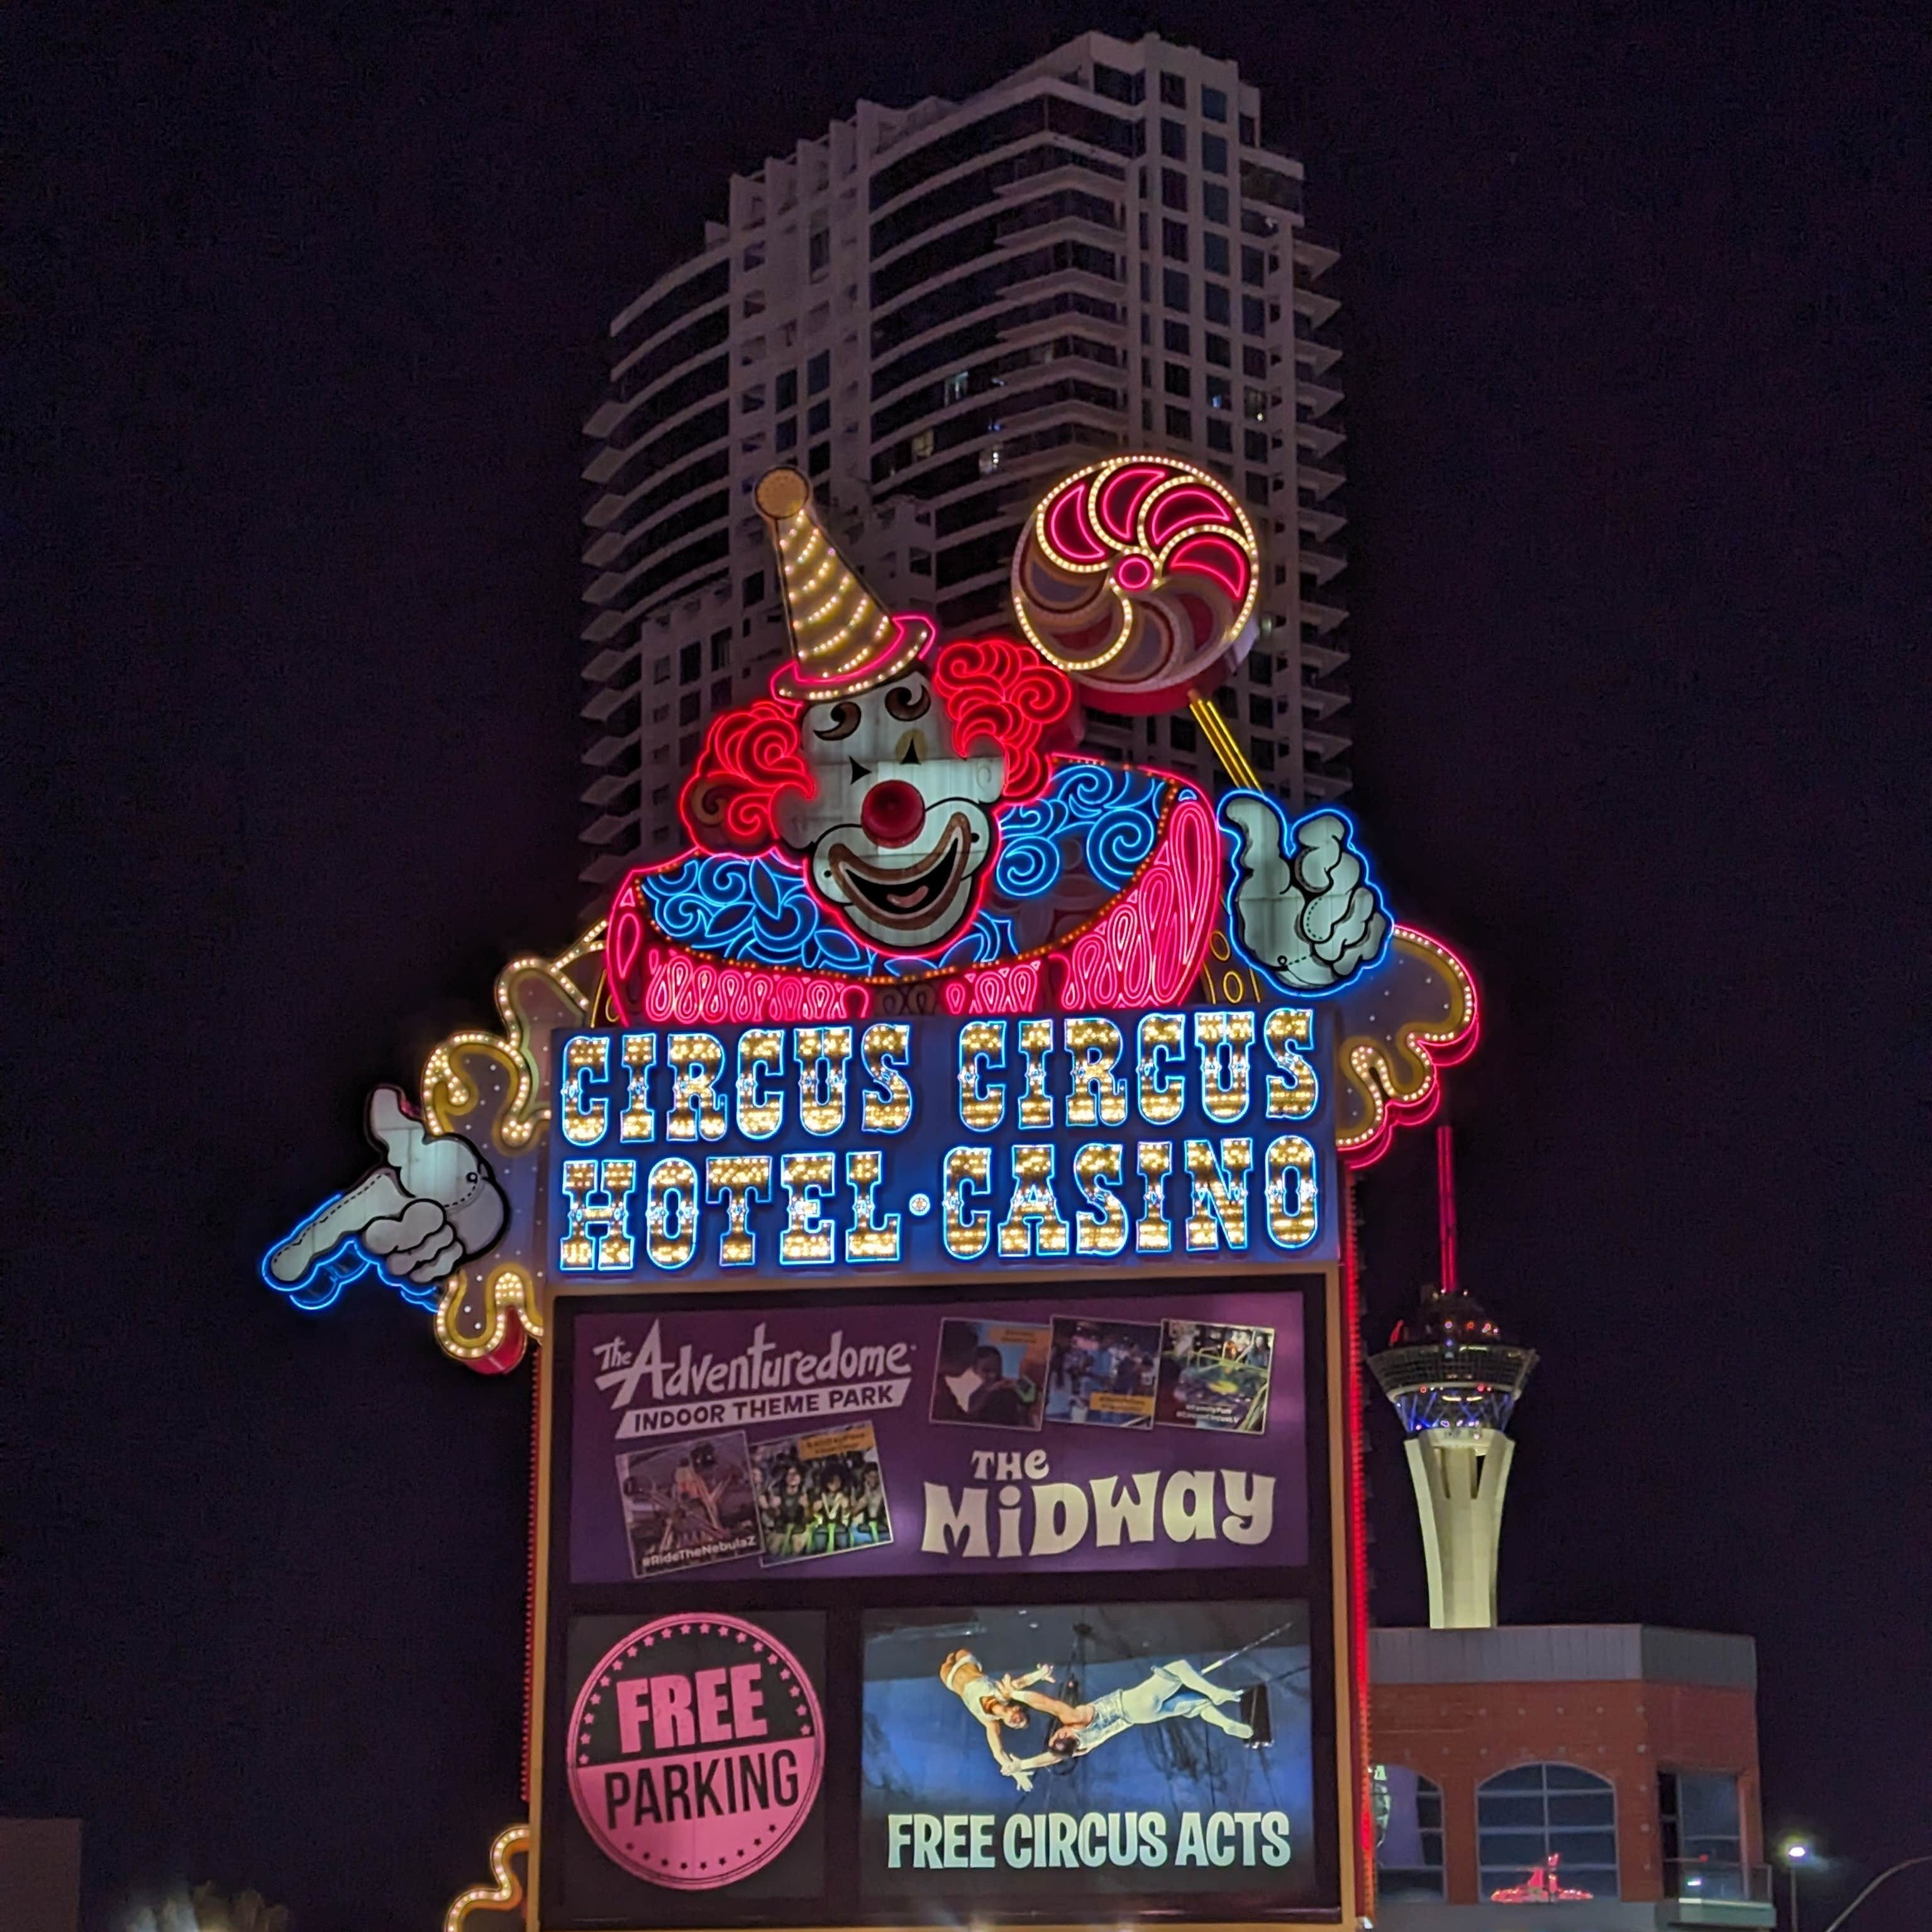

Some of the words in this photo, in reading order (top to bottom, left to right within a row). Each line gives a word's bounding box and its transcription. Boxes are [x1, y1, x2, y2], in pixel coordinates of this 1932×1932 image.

[562, 1023, 914, 1145] CIRCUS
[957, 1008, 1318, 1132] CIRCUS
[559, 1150, 901, 1271] HOTEL
[943, 1135, 1320, 1259] CASINO
[594, 1336, 631, 1370] The
[595, 1318, 911, 1409] Adventuredome
[634, 1404, 725, 1433] INDOOR
[733, 1395, 819, 1421] THEME
[829, 1385, 894, 1411] PARK
[616, 1663, 768, 1753] FREE
[604, 1749, 799, 1829] PARKING
[887, 1813, 996, 1869] FREE
[1004, 1811, 1168, 1868] CIRCUS
[1174, 1811, 1291, 1867] ACTS
